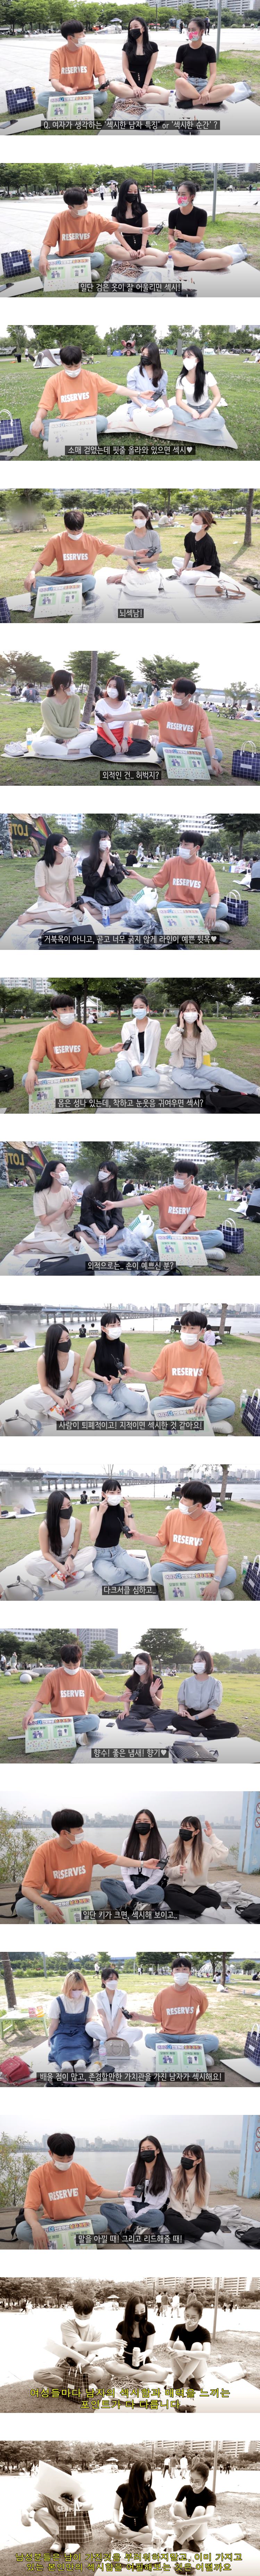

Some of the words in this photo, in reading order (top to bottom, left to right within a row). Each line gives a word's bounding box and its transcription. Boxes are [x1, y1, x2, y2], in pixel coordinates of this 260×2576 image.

[61, 66, 87, 74] RESERVES
[62, 233, 90, 241] RESERVES
[167, 722, 194, 732] RESERVES
[173, 878, 201, 889] RESERVES
[168, 1206, 191, 1215] RESERV
[172, 1368, 203, 1377] RESERVS
[173, 1534, 203, 1546] RESERVS
